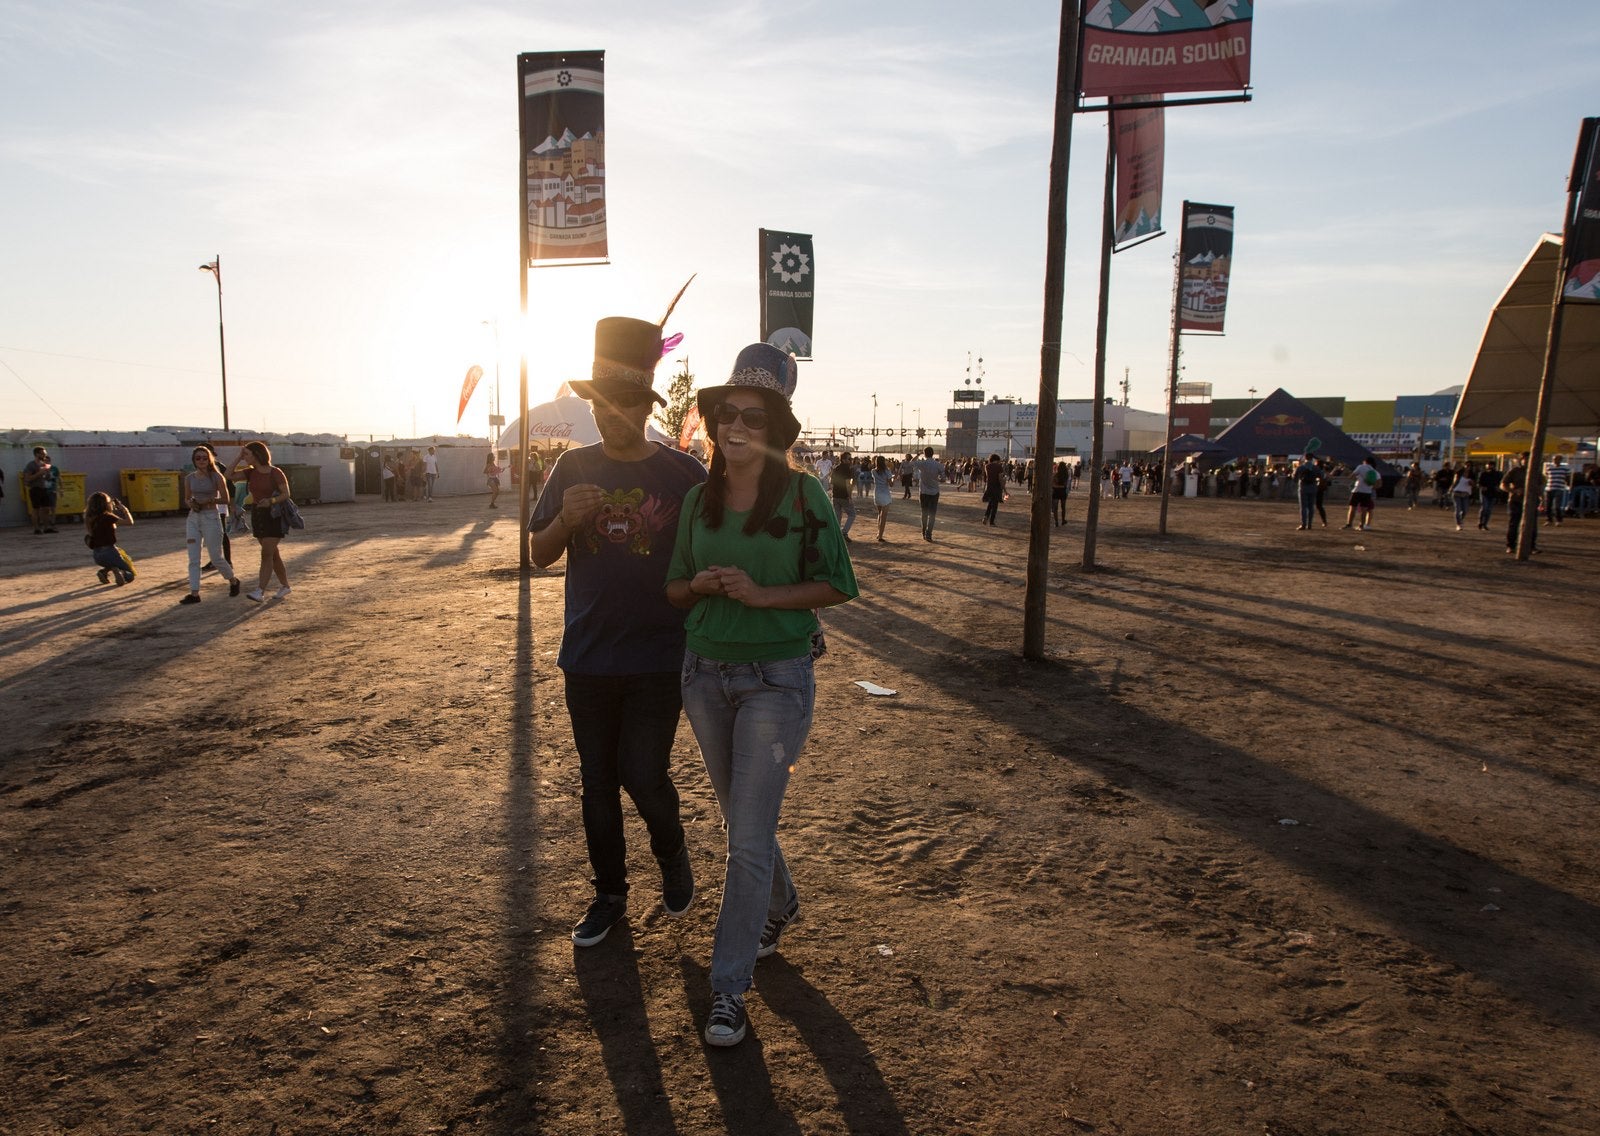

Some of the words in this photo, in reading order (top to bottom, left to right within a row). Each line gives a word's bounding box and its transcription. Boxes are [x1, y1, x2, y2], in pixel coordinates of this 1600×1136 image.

[1088, 43, 1177, 66] GRANADA
[1182, 37, 1245, 63] SOUND
[769, 290, 793, 298] GRANADA
